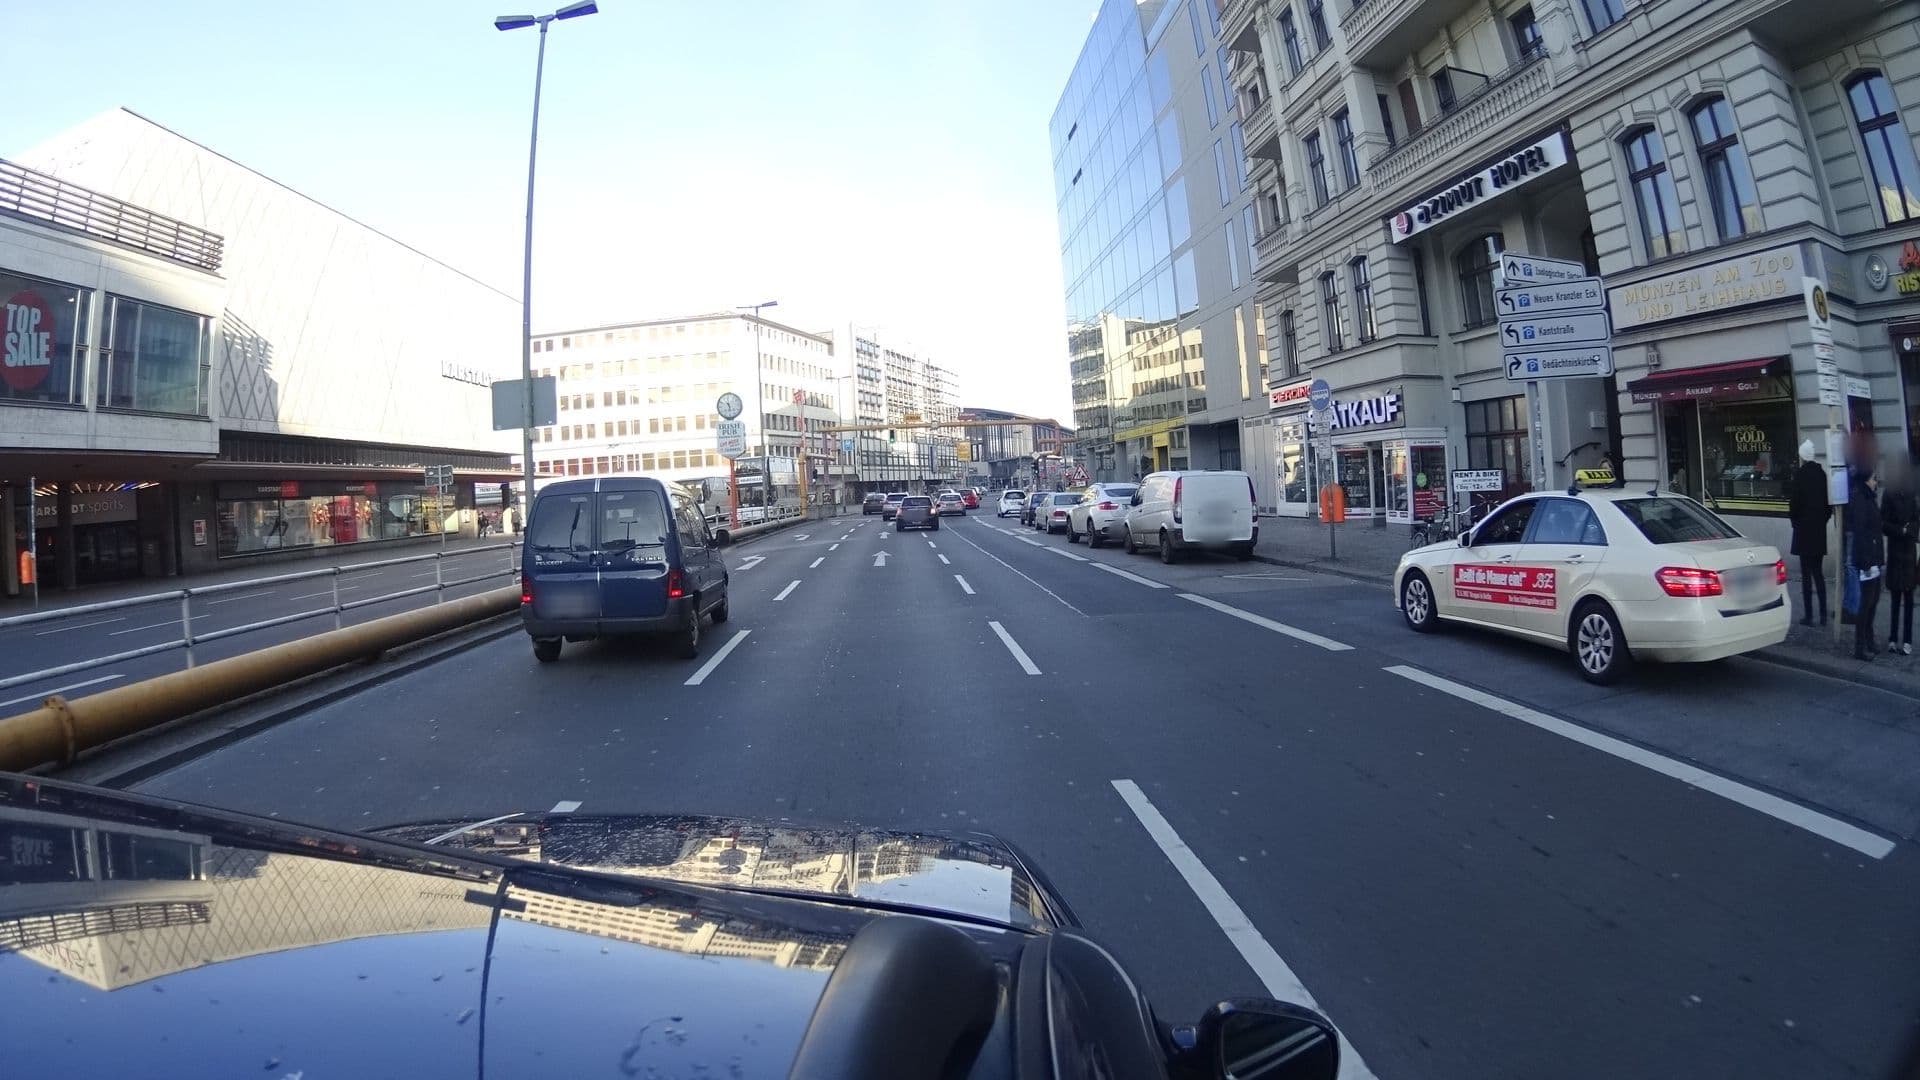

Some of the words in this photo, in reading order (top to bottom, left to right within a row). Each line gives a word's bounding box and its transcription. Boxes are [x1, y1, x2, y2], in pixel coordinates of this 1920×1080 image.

[1490, 146, 1549, 188] HOTEL
[1712, 264, 1740, 287] AM
[1751, 254, 1795, 277] ZOO
[1534, 294, 1554, 304] Neues
[1556, 290, 1583, 302] Kranzler
[1585, 288, 1598, 299] Eck
[1636, 302, 1675, 321] UND
[1684, 277, 1788, 312] LEIHHAUS
[7, 304, 41, 334] TOP
[1538, 324, 1575, 337] Kantstraße
[5, 332, 50, 367] SALE
[1308, 391, 1398, 432] SÄTKAUF
[1735, 430, 1765, 443] GOLD
[1454, 471, 1474, 479] RENT
[1583, 470, 1615, 480] TAXI
